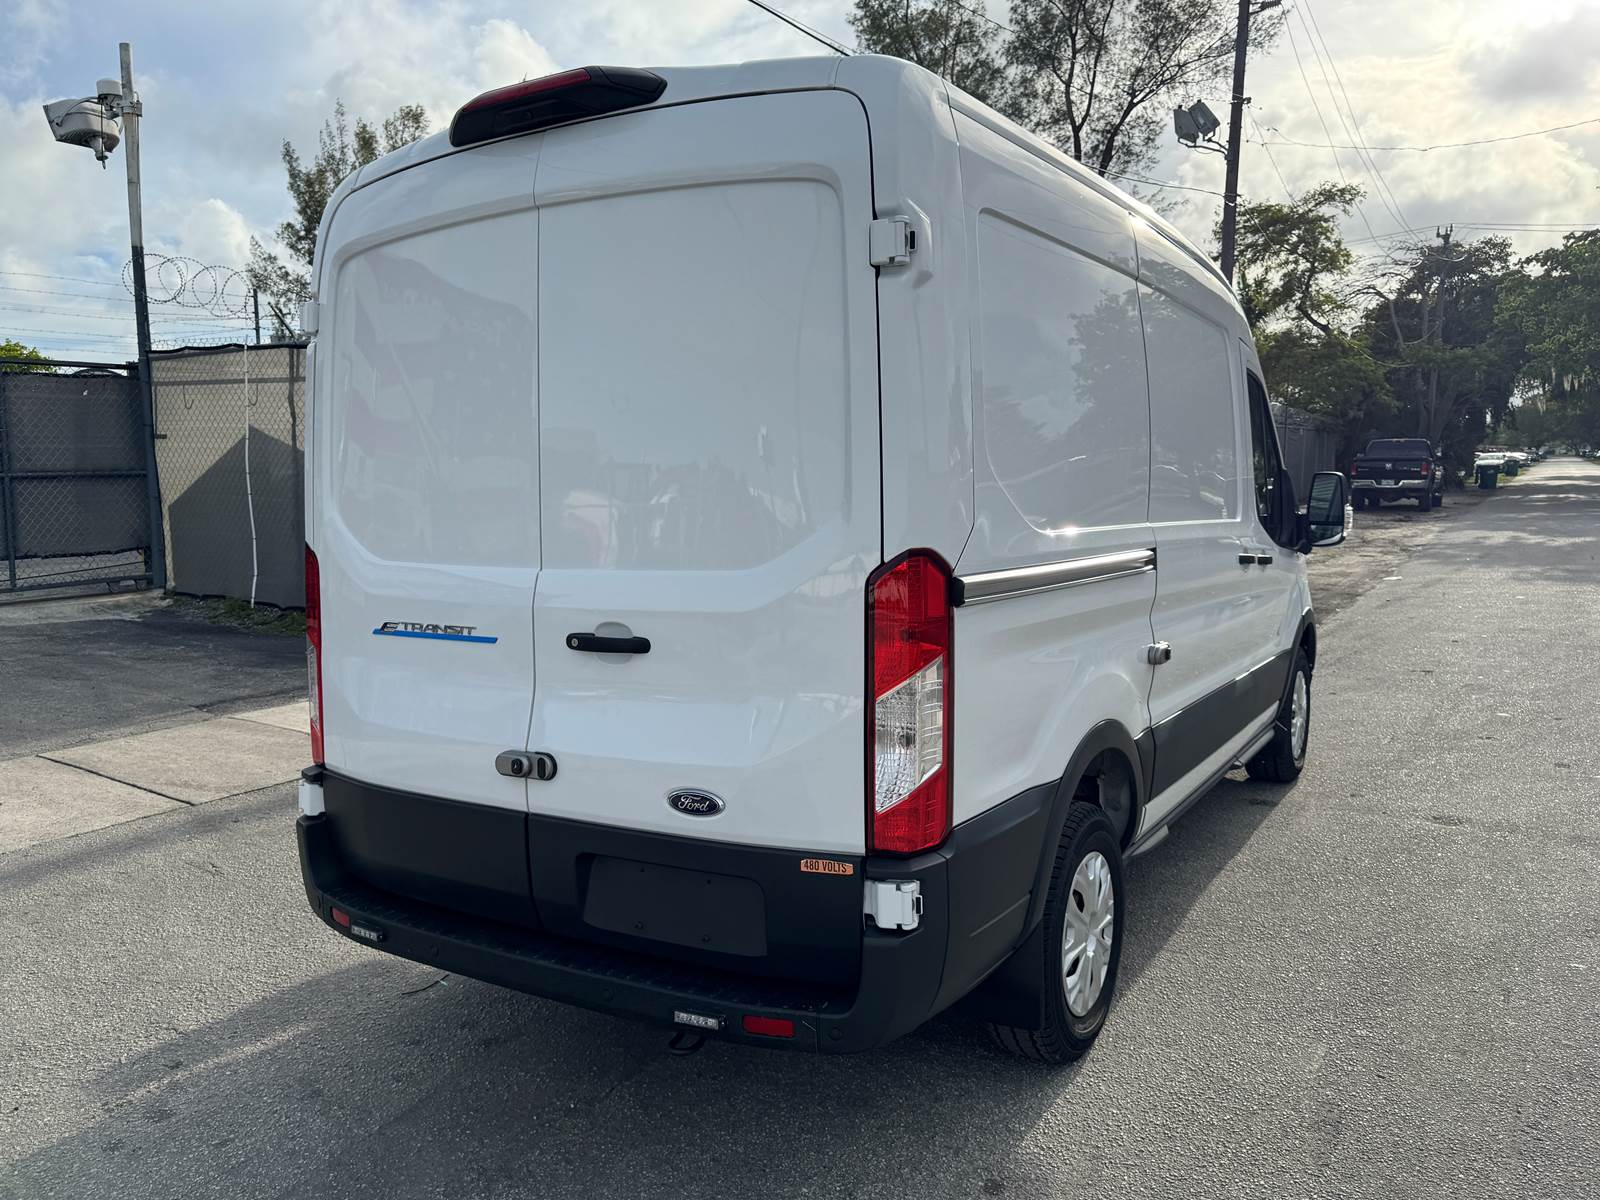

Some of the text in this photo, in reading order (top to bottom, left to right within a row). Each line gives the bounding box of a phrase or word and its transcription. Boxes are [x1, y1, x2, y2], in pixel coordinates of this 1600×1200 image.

[678, 795, 709, 812] Ford
[804, 859, 847, 873] 480 VOLTS
